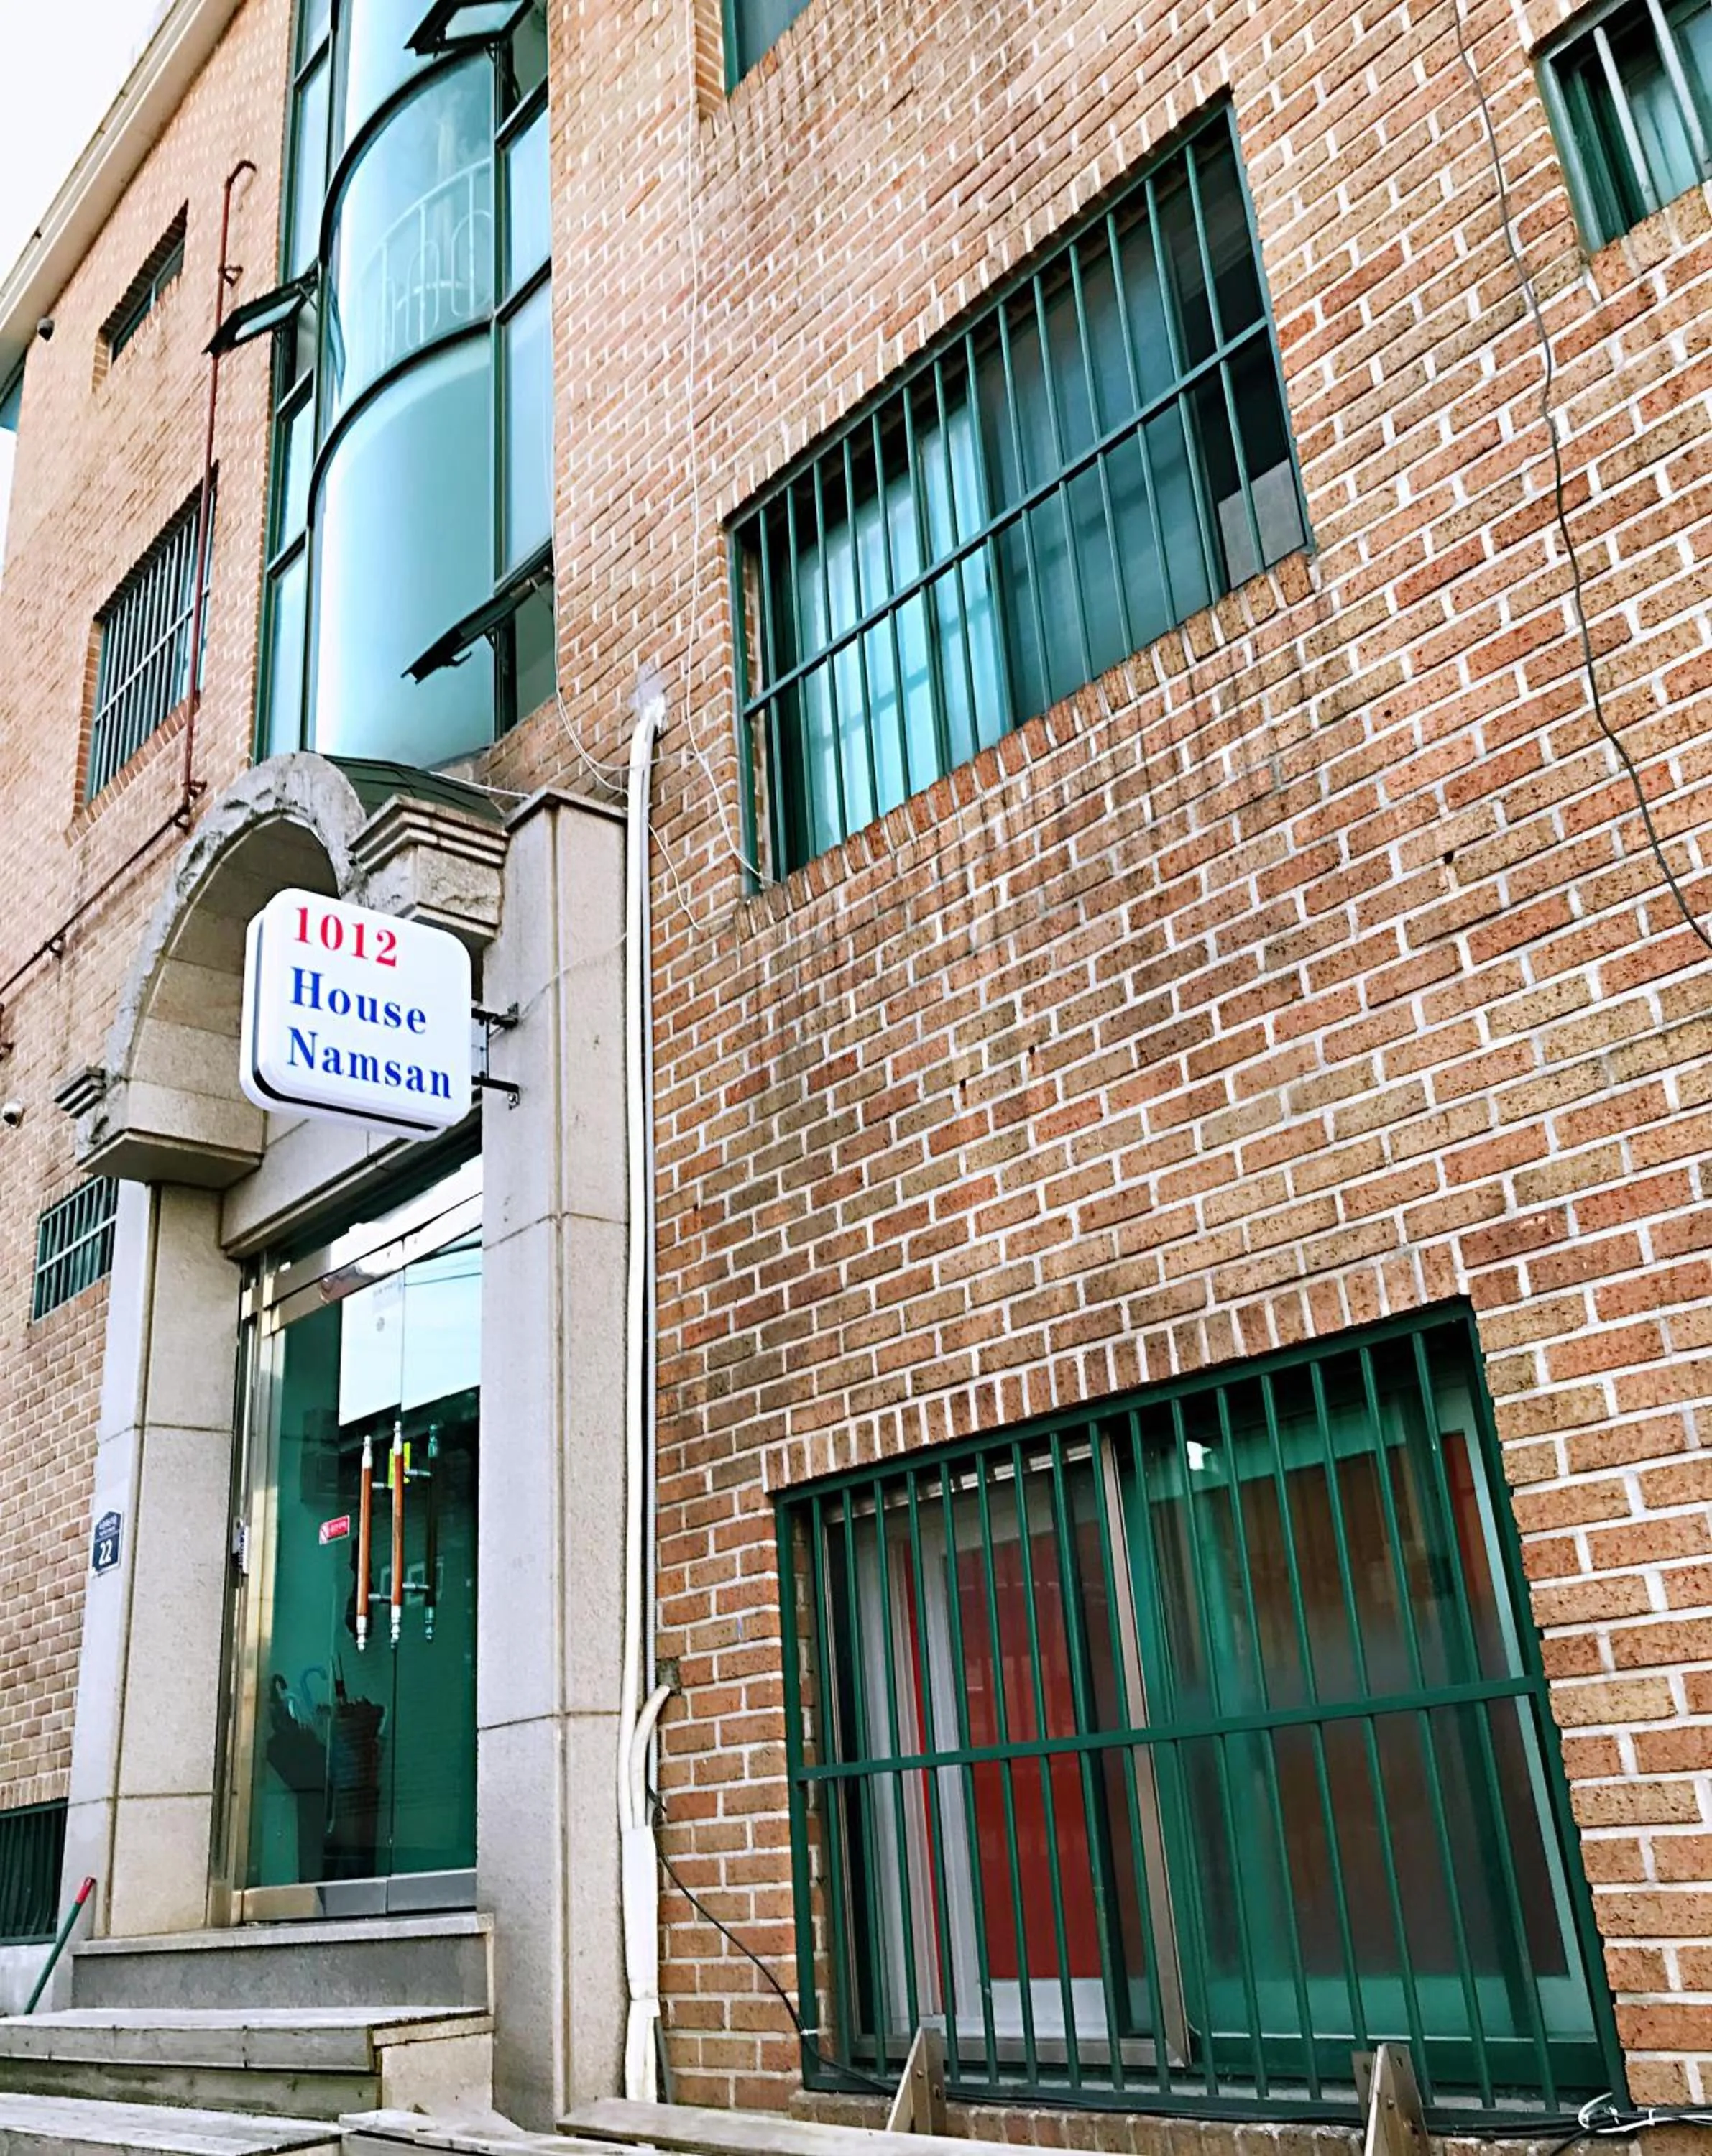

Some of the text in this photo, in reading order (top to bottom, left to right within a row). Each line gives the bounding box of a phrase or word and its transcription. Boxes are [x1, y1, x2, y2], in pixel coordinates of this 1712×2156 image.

[293, 906, 397, 967] 1012
[290, 966, 426, 1034] House
[287, 1026, 451, 1099] Namsan
[98, 1539, 112, 1565] 22
